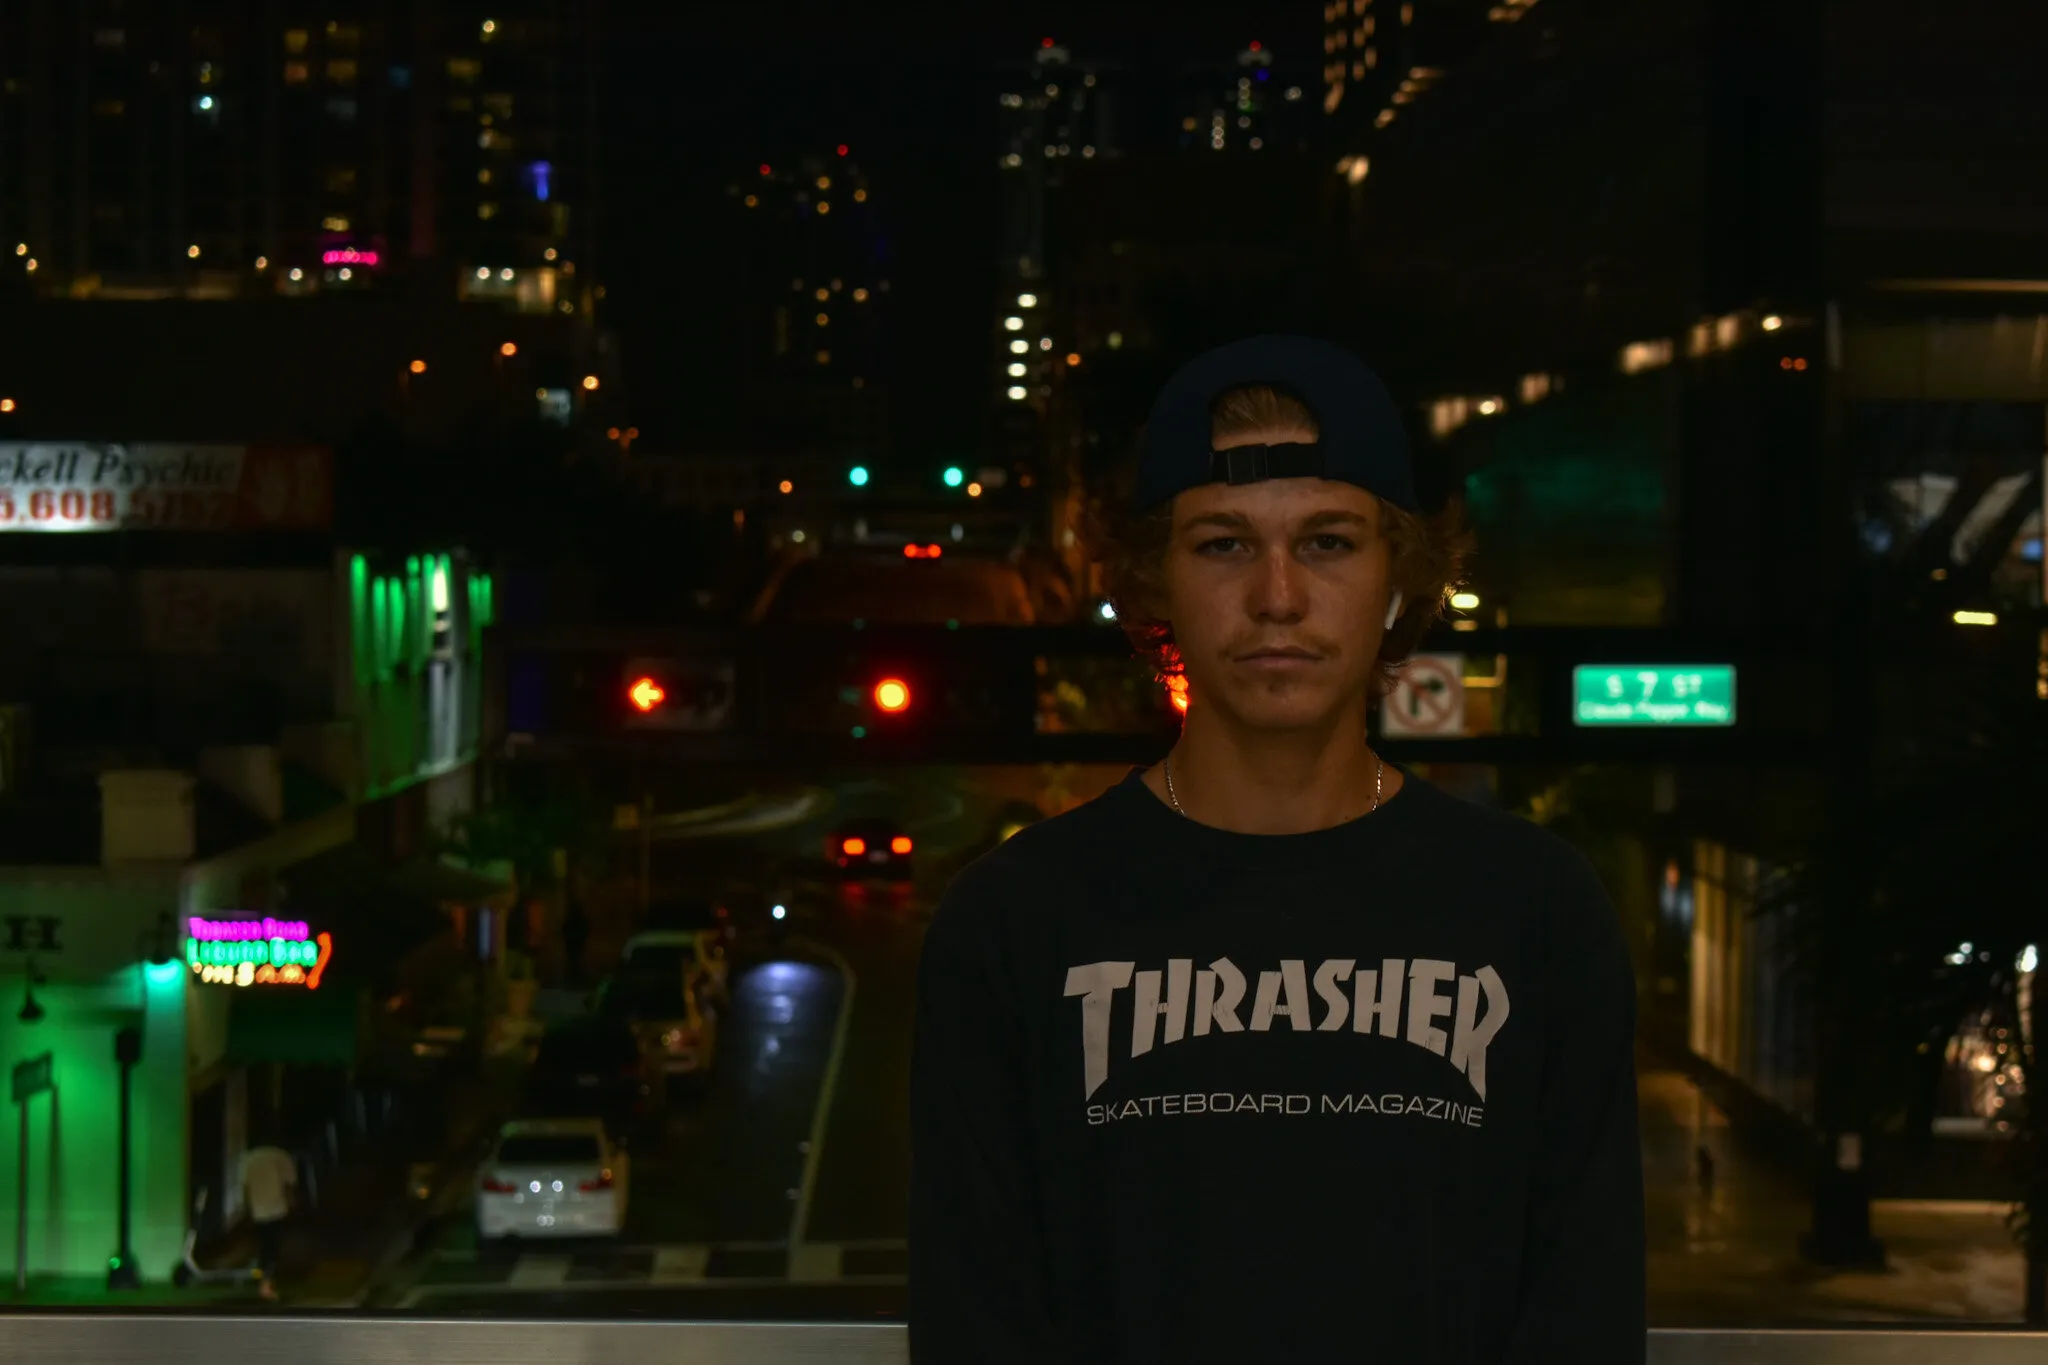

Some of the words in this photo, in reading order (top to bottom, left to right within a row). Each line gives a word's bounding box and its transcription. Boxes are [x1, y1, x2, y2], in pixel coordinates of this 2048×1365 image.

[1636, 670, 1659, 700] 7
[1063, 957, 1510, 1102] THRASHER
[1087, 1092, 1311, 1126] SKATEBOARD
[1321, 1093, 1485, 1128] MAGAZINE
